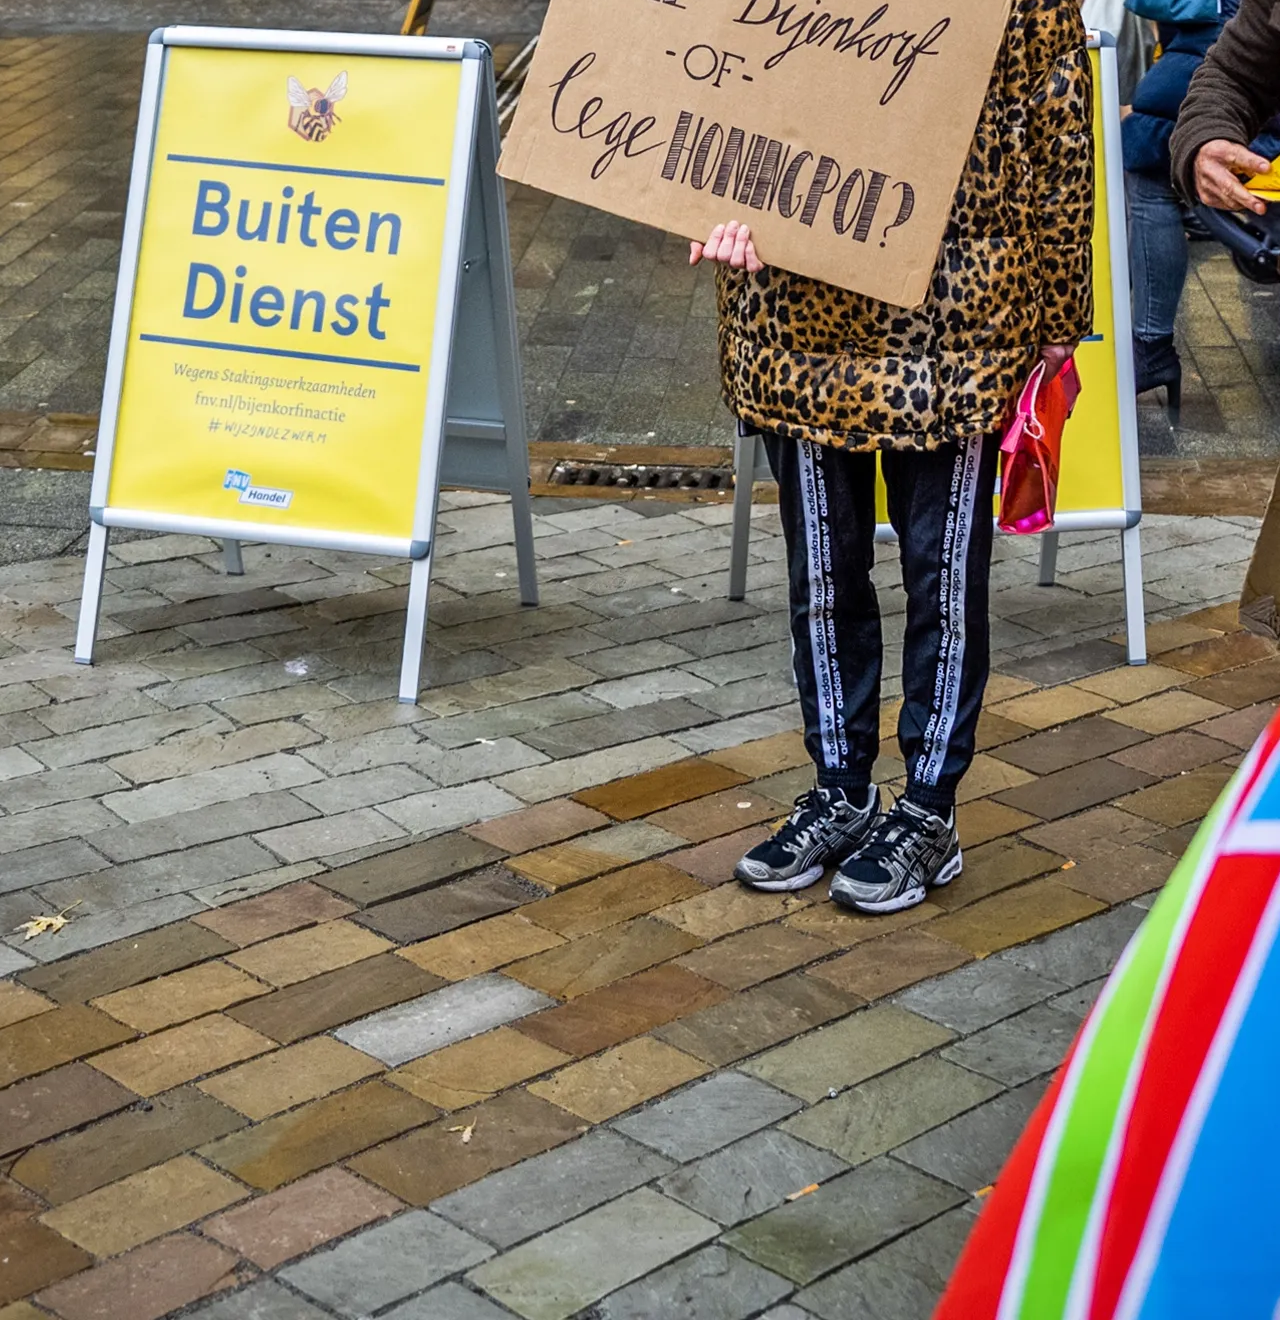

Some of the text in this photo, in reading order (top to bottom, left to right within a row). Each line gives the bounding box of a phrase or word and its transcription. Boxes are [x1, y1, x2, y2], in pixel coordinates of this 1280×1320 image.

[191, 179, 403, 256] Buiten
[182, 261, 391, 341] Dienst
[174, 362, 377, 399] Wegens Stakingswerkzaamheden
[195, 391, 347, 423] fnv.nl/bijenkorfinactie
[950, 454, 963, 493] adidas
[963, 454, 975, 493] adidas
[247, 489, 286, 504] Handel
[806, 477, 817, 516] adidas
[817, 478, 828, 518] adidas
[943, 510, 955, 550] adidas
[955, 511, 967, 550] adidas
[810, 532, 820, 571] adidas
[822, 534, 832, 573] adidas
[815, 619, 826, 656] adidas
[821, 671, 832, 710] adidas
[833, 670, 844, 710] adidas
[934, 661, 945, 698] adidas
[945, 663, 957, 701] adidas
